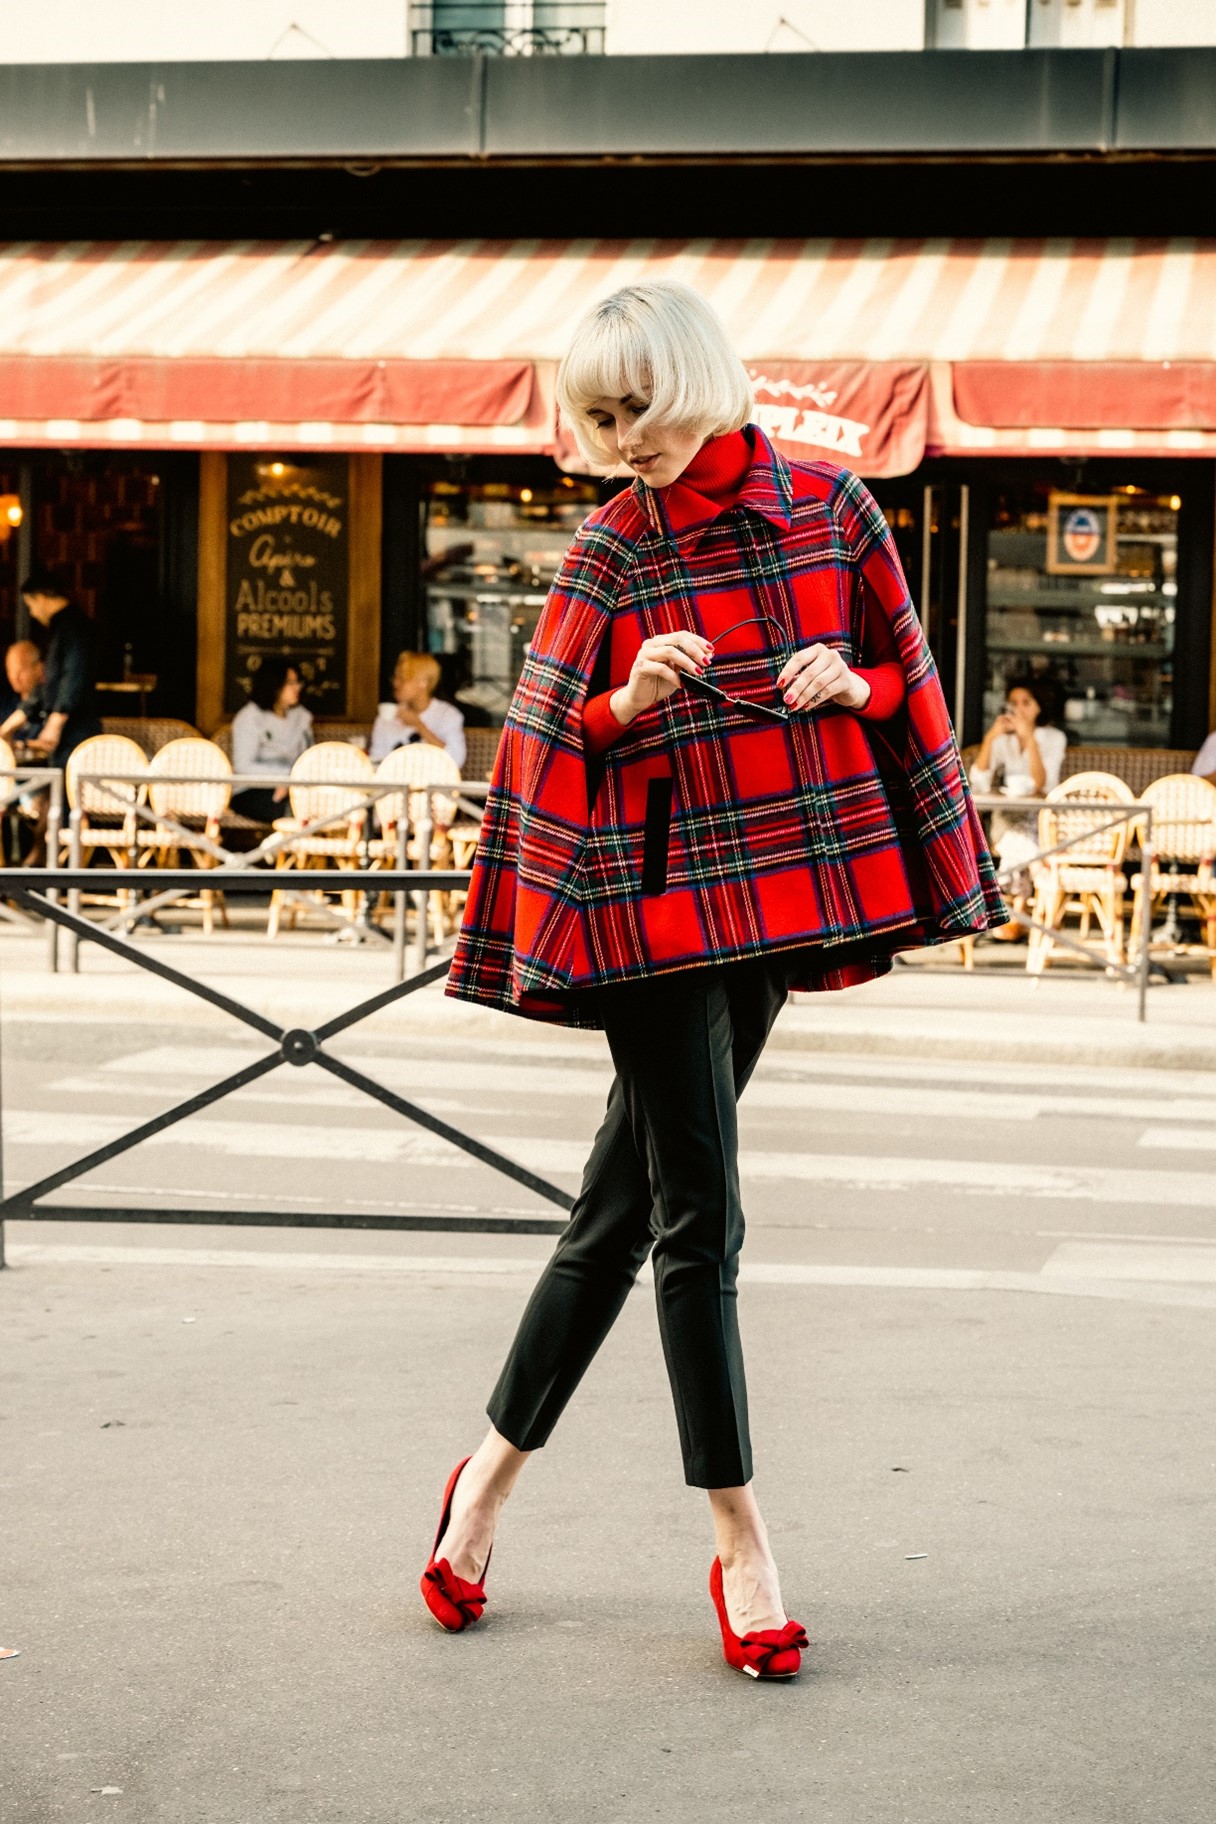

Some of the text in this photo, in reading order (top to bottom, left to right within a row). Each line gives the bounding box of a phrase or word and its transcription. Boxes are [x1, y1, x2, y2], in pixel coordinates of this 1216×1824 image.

[230, 505, 342, 538] COMPTOIR
[236, 579, 333, 612] Alcools
[237, 613, 336, 639] PREMIUMS
